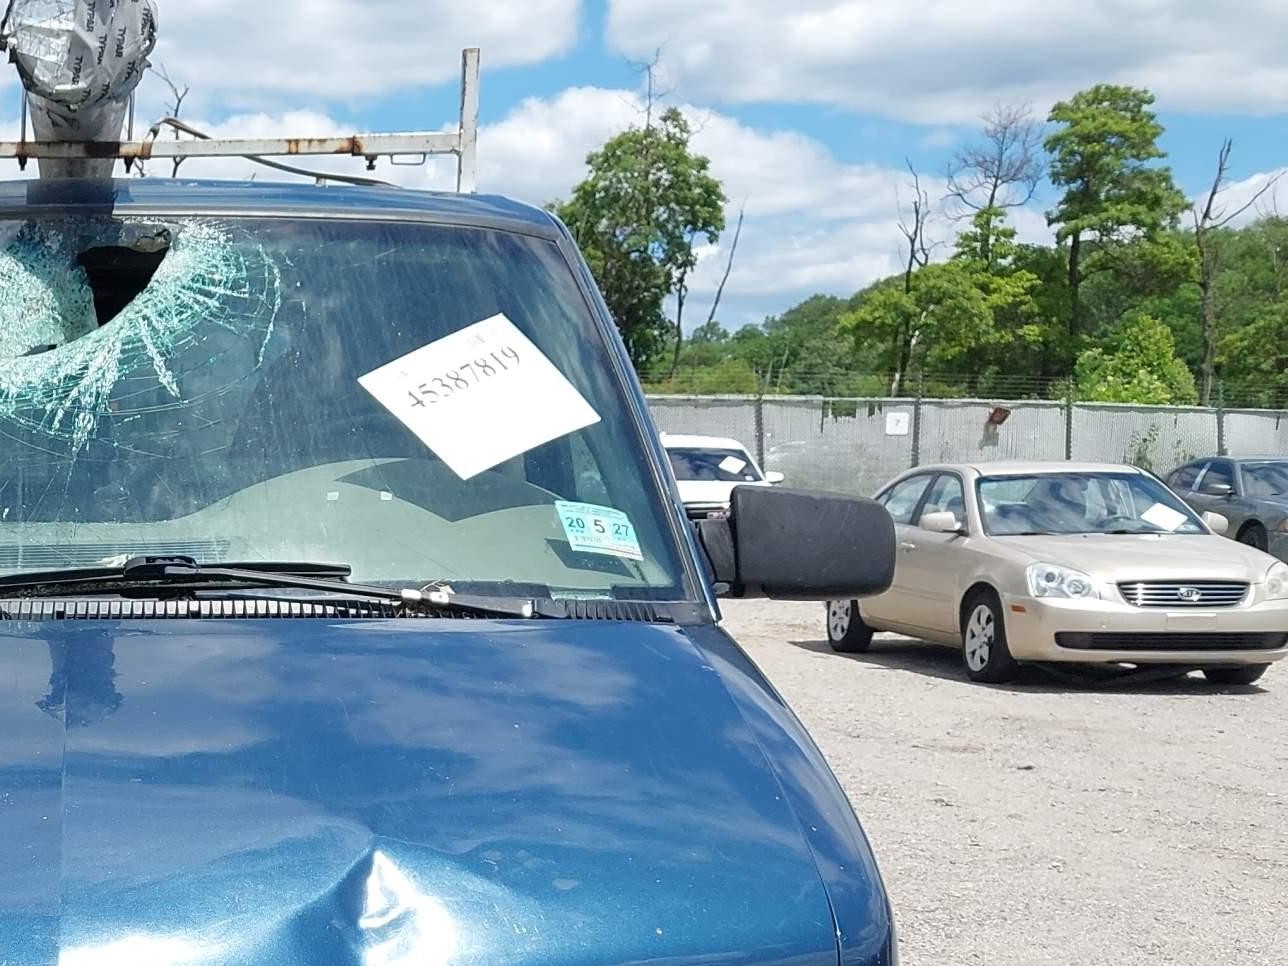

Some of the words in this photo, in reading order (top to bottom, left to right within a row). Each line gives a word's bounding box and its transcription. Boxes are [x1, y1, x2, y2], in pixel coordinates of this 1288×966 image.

[86, 0, 96, 32] TYPAR
[115, 27, 127, 58] TYPAR
[72, 56, 84, 85] TYPAR
[408, 346, 520, 407] 45387819
[565, 516, 585, 529] 20
[593, 519, 606, 533] 5
[612, 523, 629, 536] 27
